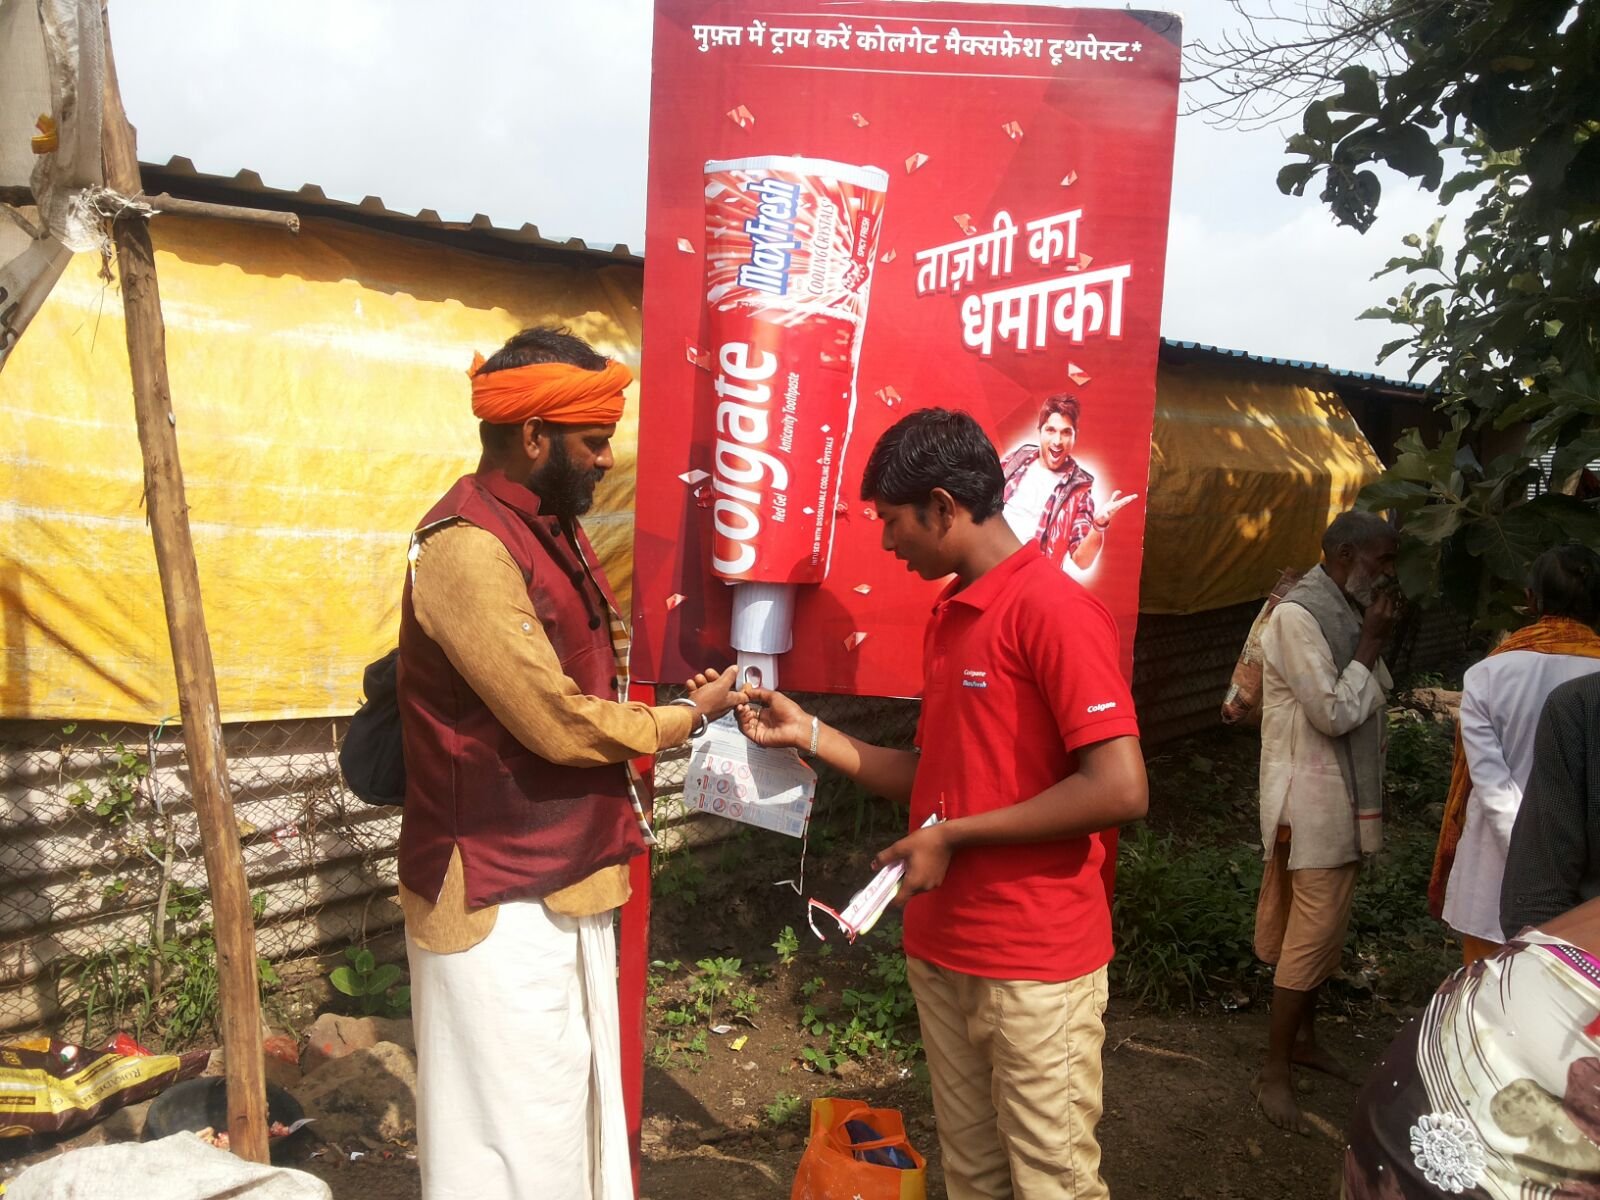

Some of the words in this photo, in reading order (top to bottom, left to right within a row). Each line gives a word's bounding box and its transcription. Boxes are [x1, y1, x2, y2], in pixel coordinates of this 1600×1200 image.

[747, 19, 767, 47] में
[769, 27, 811, 54] ट्राय
[815, 23, 852, 50] करें
[855, 25, 939, 54] कोलगेट
[944, 28, 1043, 58] मैक्सफ्रेश
[916, 211, 1018, 292] ताज़गी
[1026, 209, 1082, 265] का
[961, 264, 1131, 355] धमाका
[782, 372, 800, 414] Toothpaste
[778, 414, 798, 453] Anticavity
[823, 437, 834, 465] CRYSTALS
[713, 341, 788, 575] Colgate
[820, 466, 830, 489] COOLING
[771, 506, 786, 522] Red
[772, 492, 787, 507] Gel
[816, 490, 827, 527] DISSOLVABLE
[814, 527, 823, 541] WITH
[1087, 701, 1117, 713] Colgate
